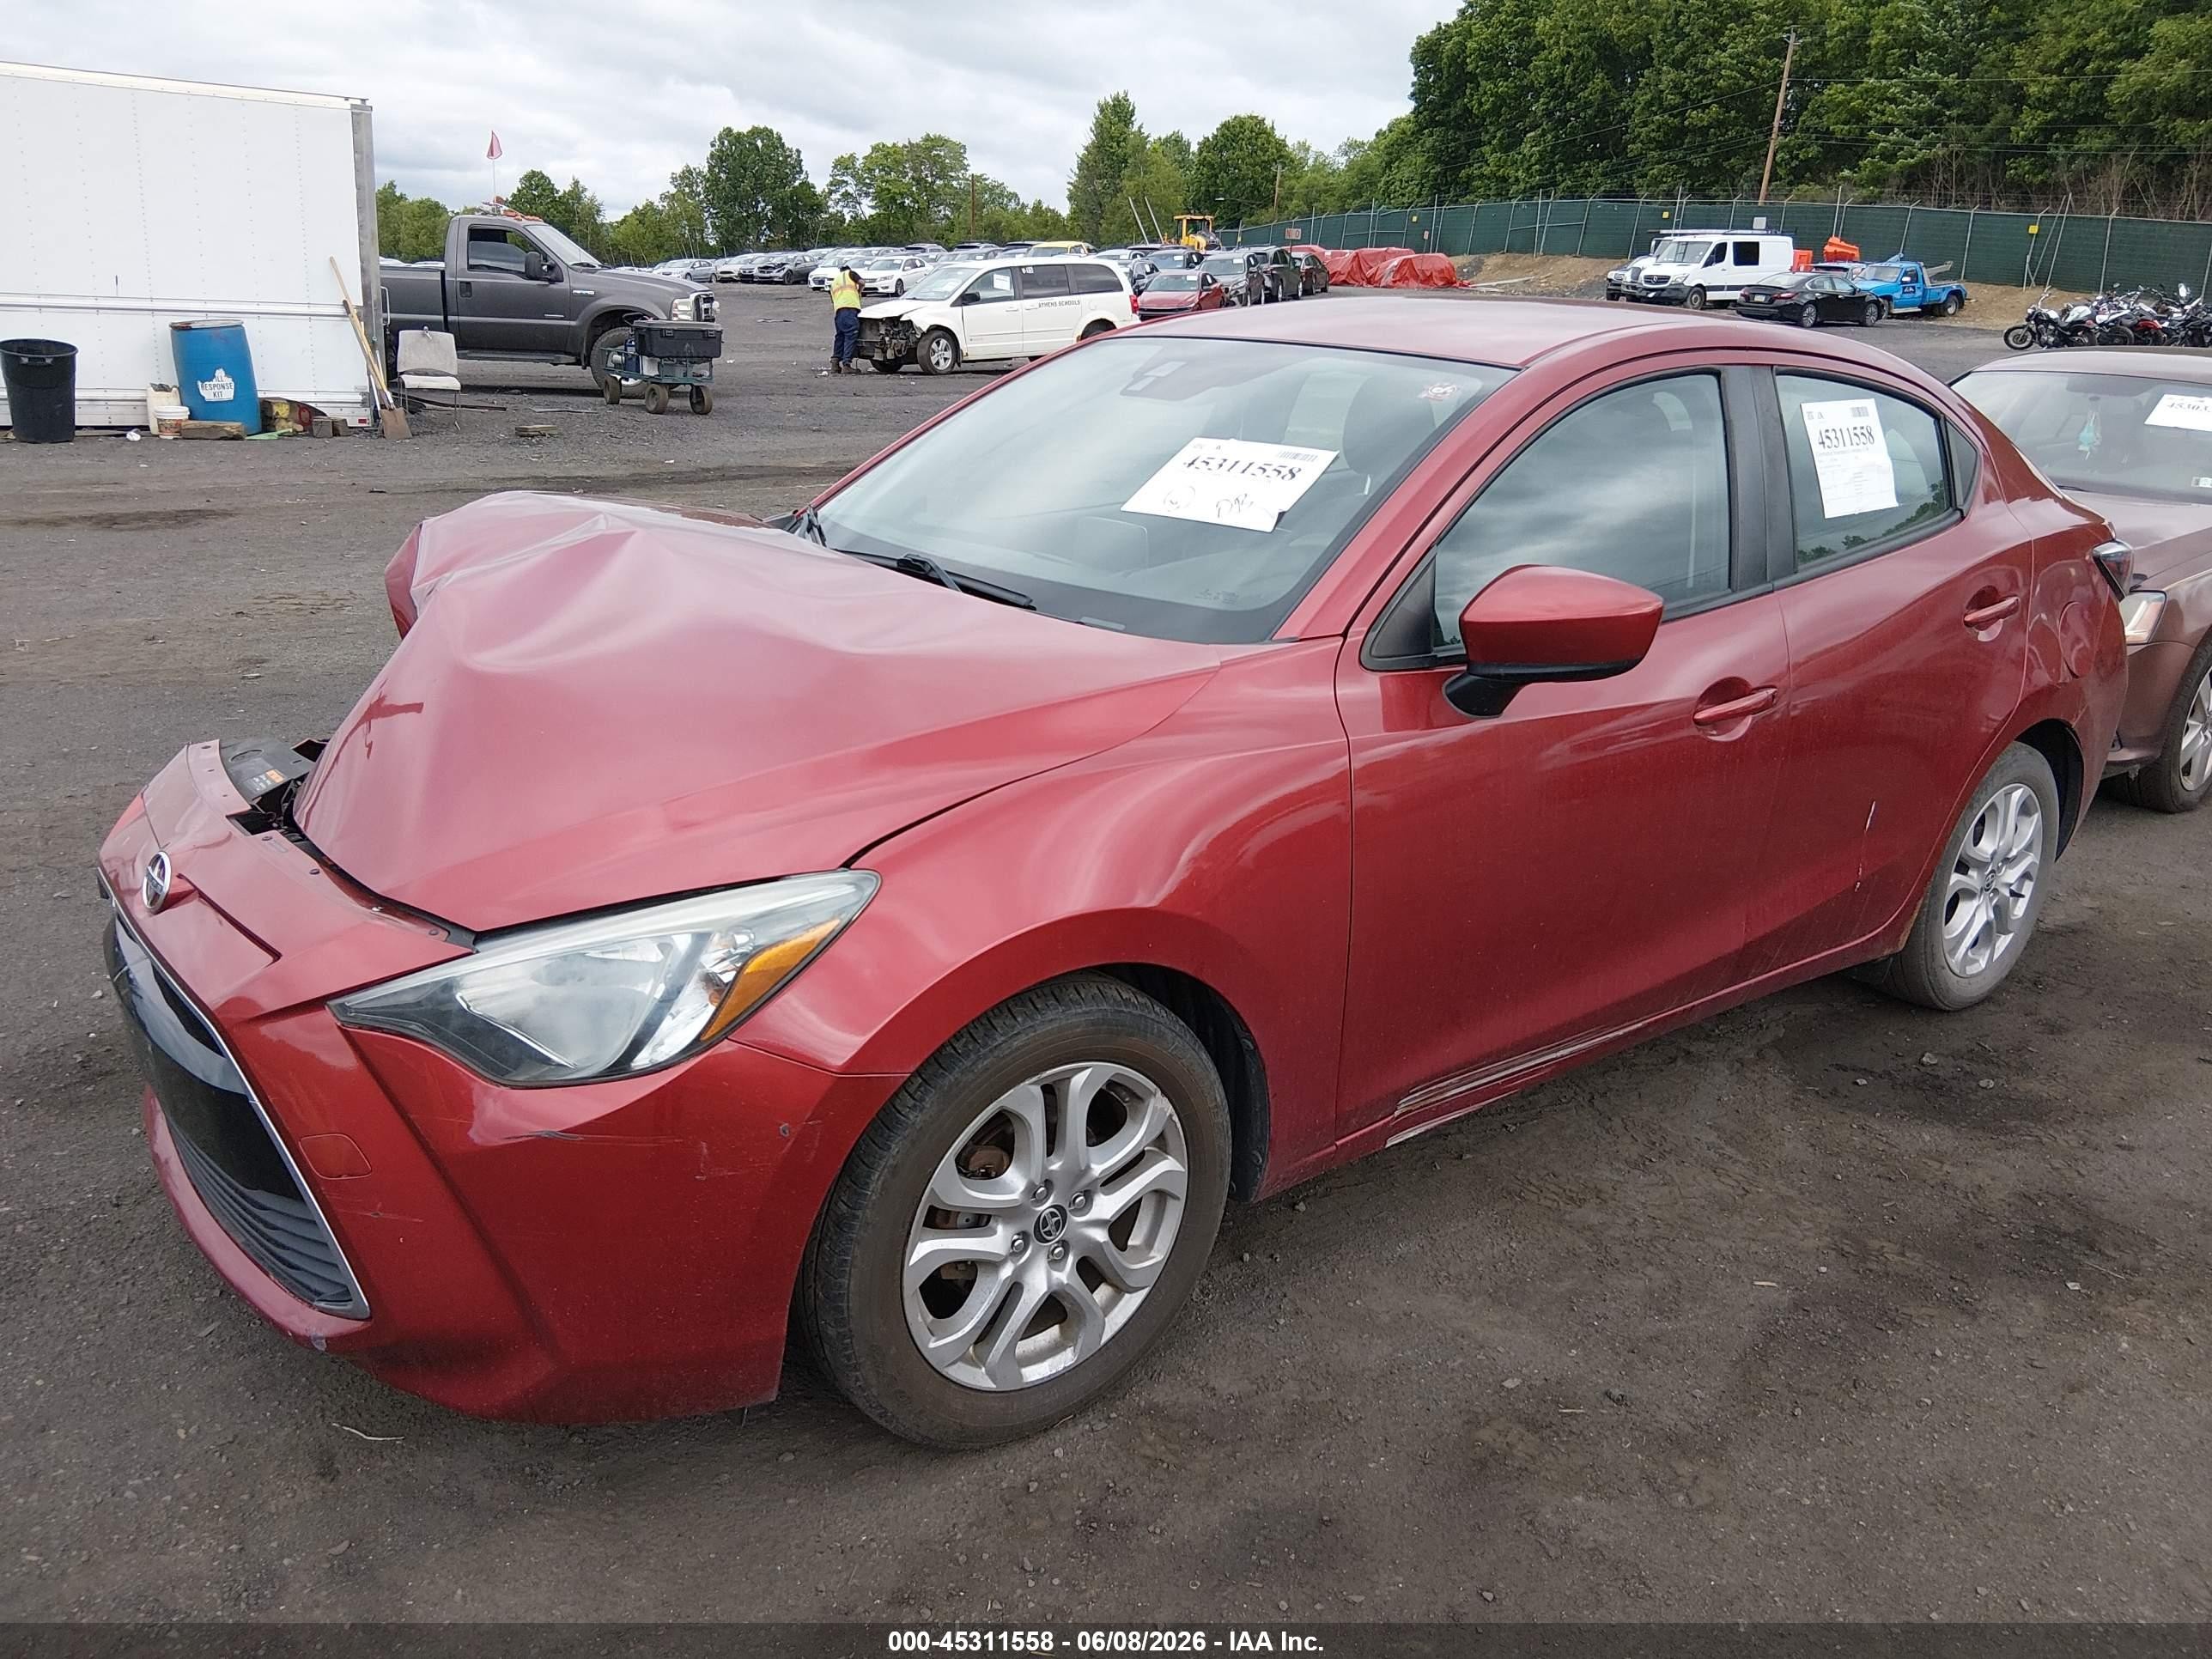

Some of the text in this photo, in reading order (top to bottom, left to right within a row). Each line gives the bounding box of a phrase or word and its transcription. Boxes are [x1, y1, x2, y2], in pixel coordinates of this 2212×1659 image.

[201, 382, 234, 392] RESPONSE
[1818, 425, 1875, 450] 45311558
[1182, 455, 1303, 481] 45311558
